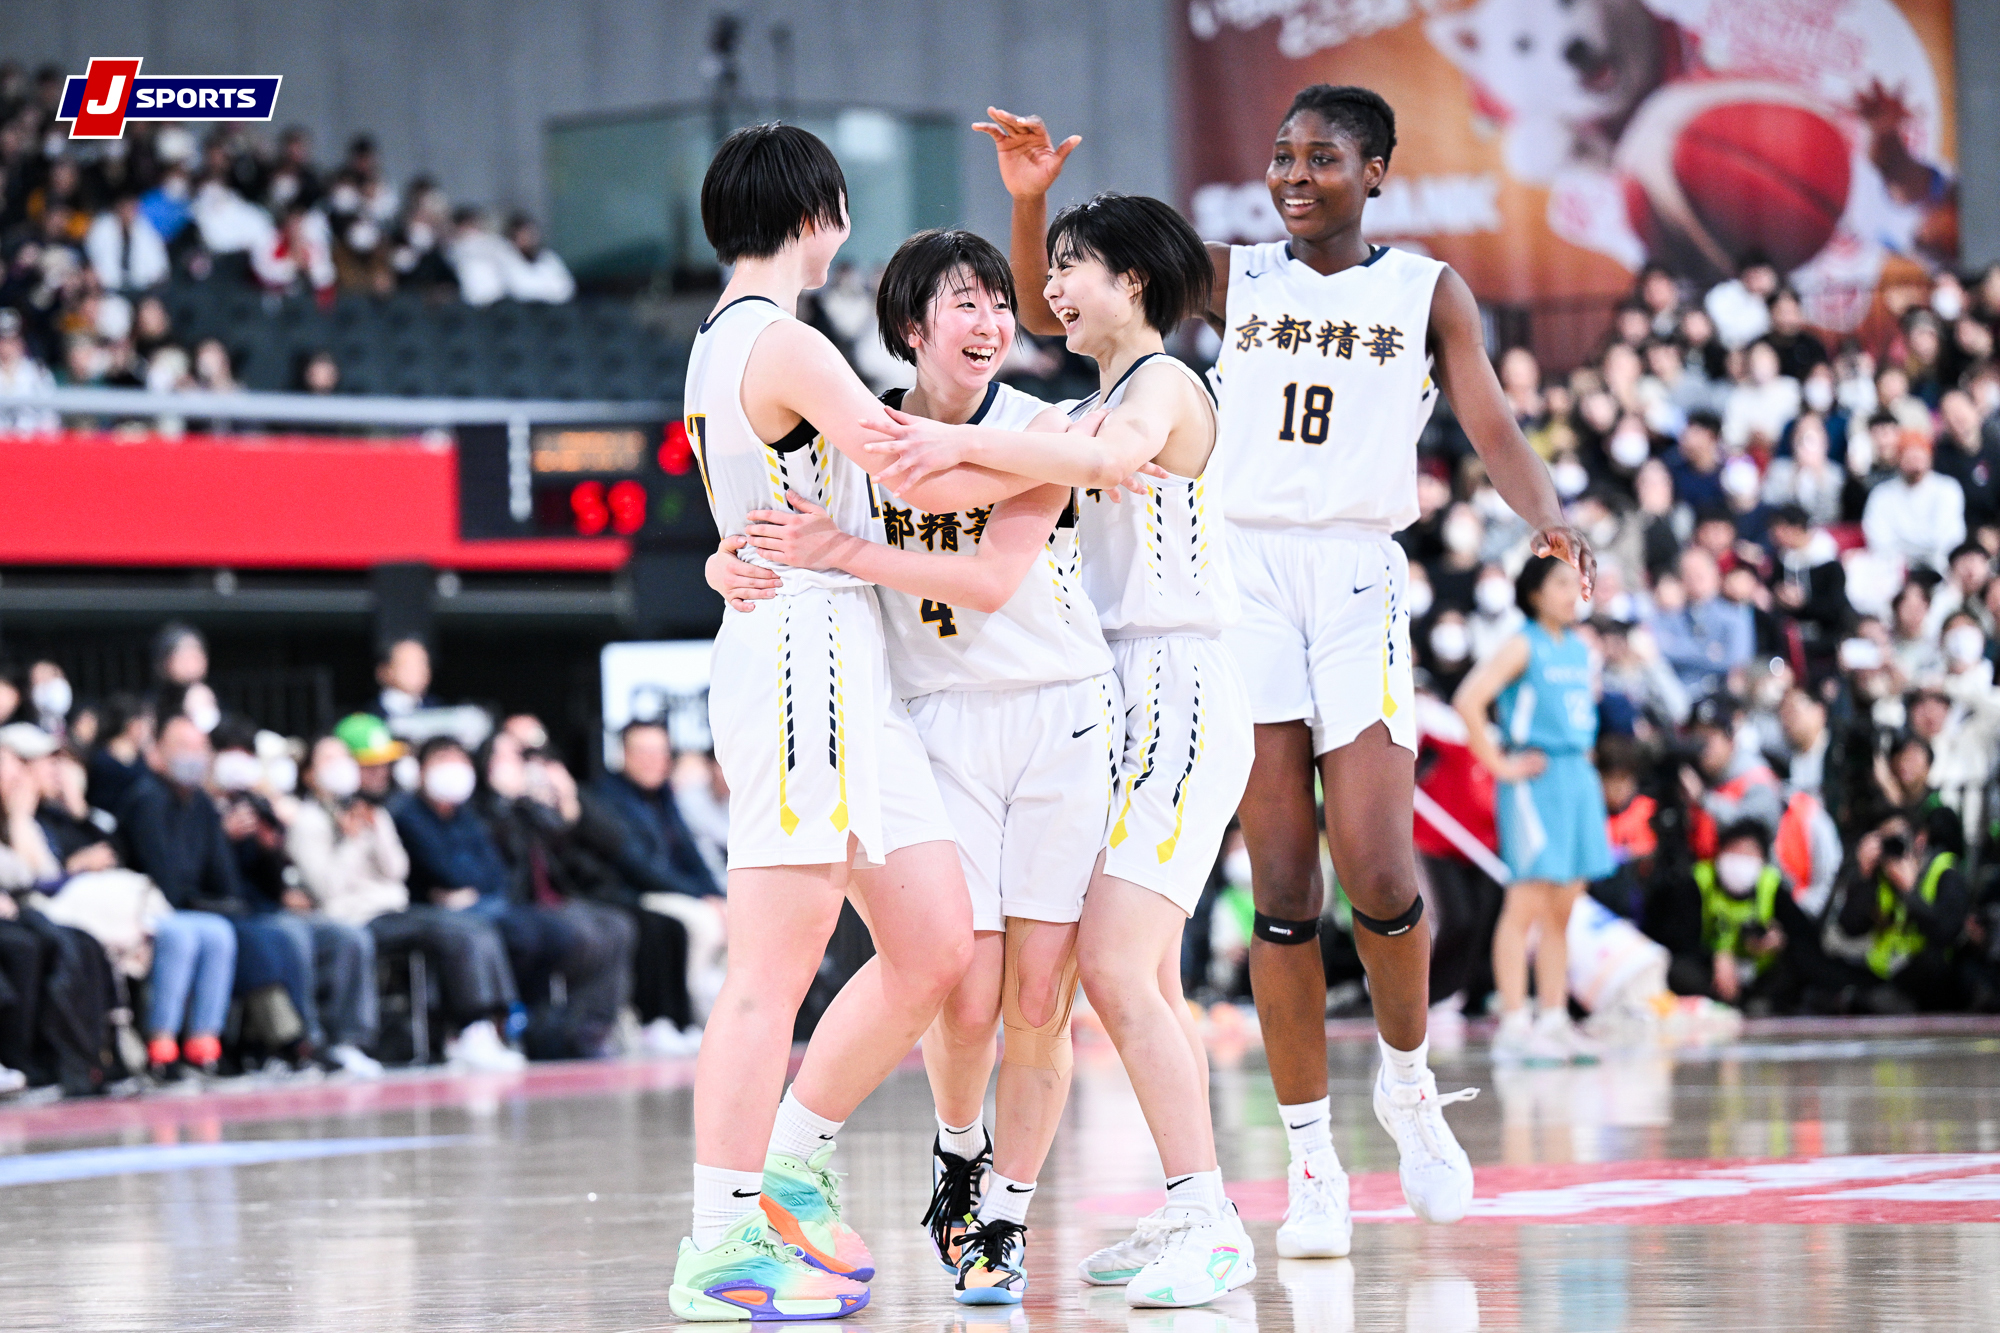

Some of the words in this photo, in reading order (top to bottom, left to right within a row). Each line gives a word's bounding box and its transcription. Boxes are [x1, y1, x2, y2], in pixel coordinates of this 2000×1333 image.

[1235, 314, 1405, 366] 京都精華
[1278, 381, 1334, 445] 18
[919, 597, 958, 639] 4
